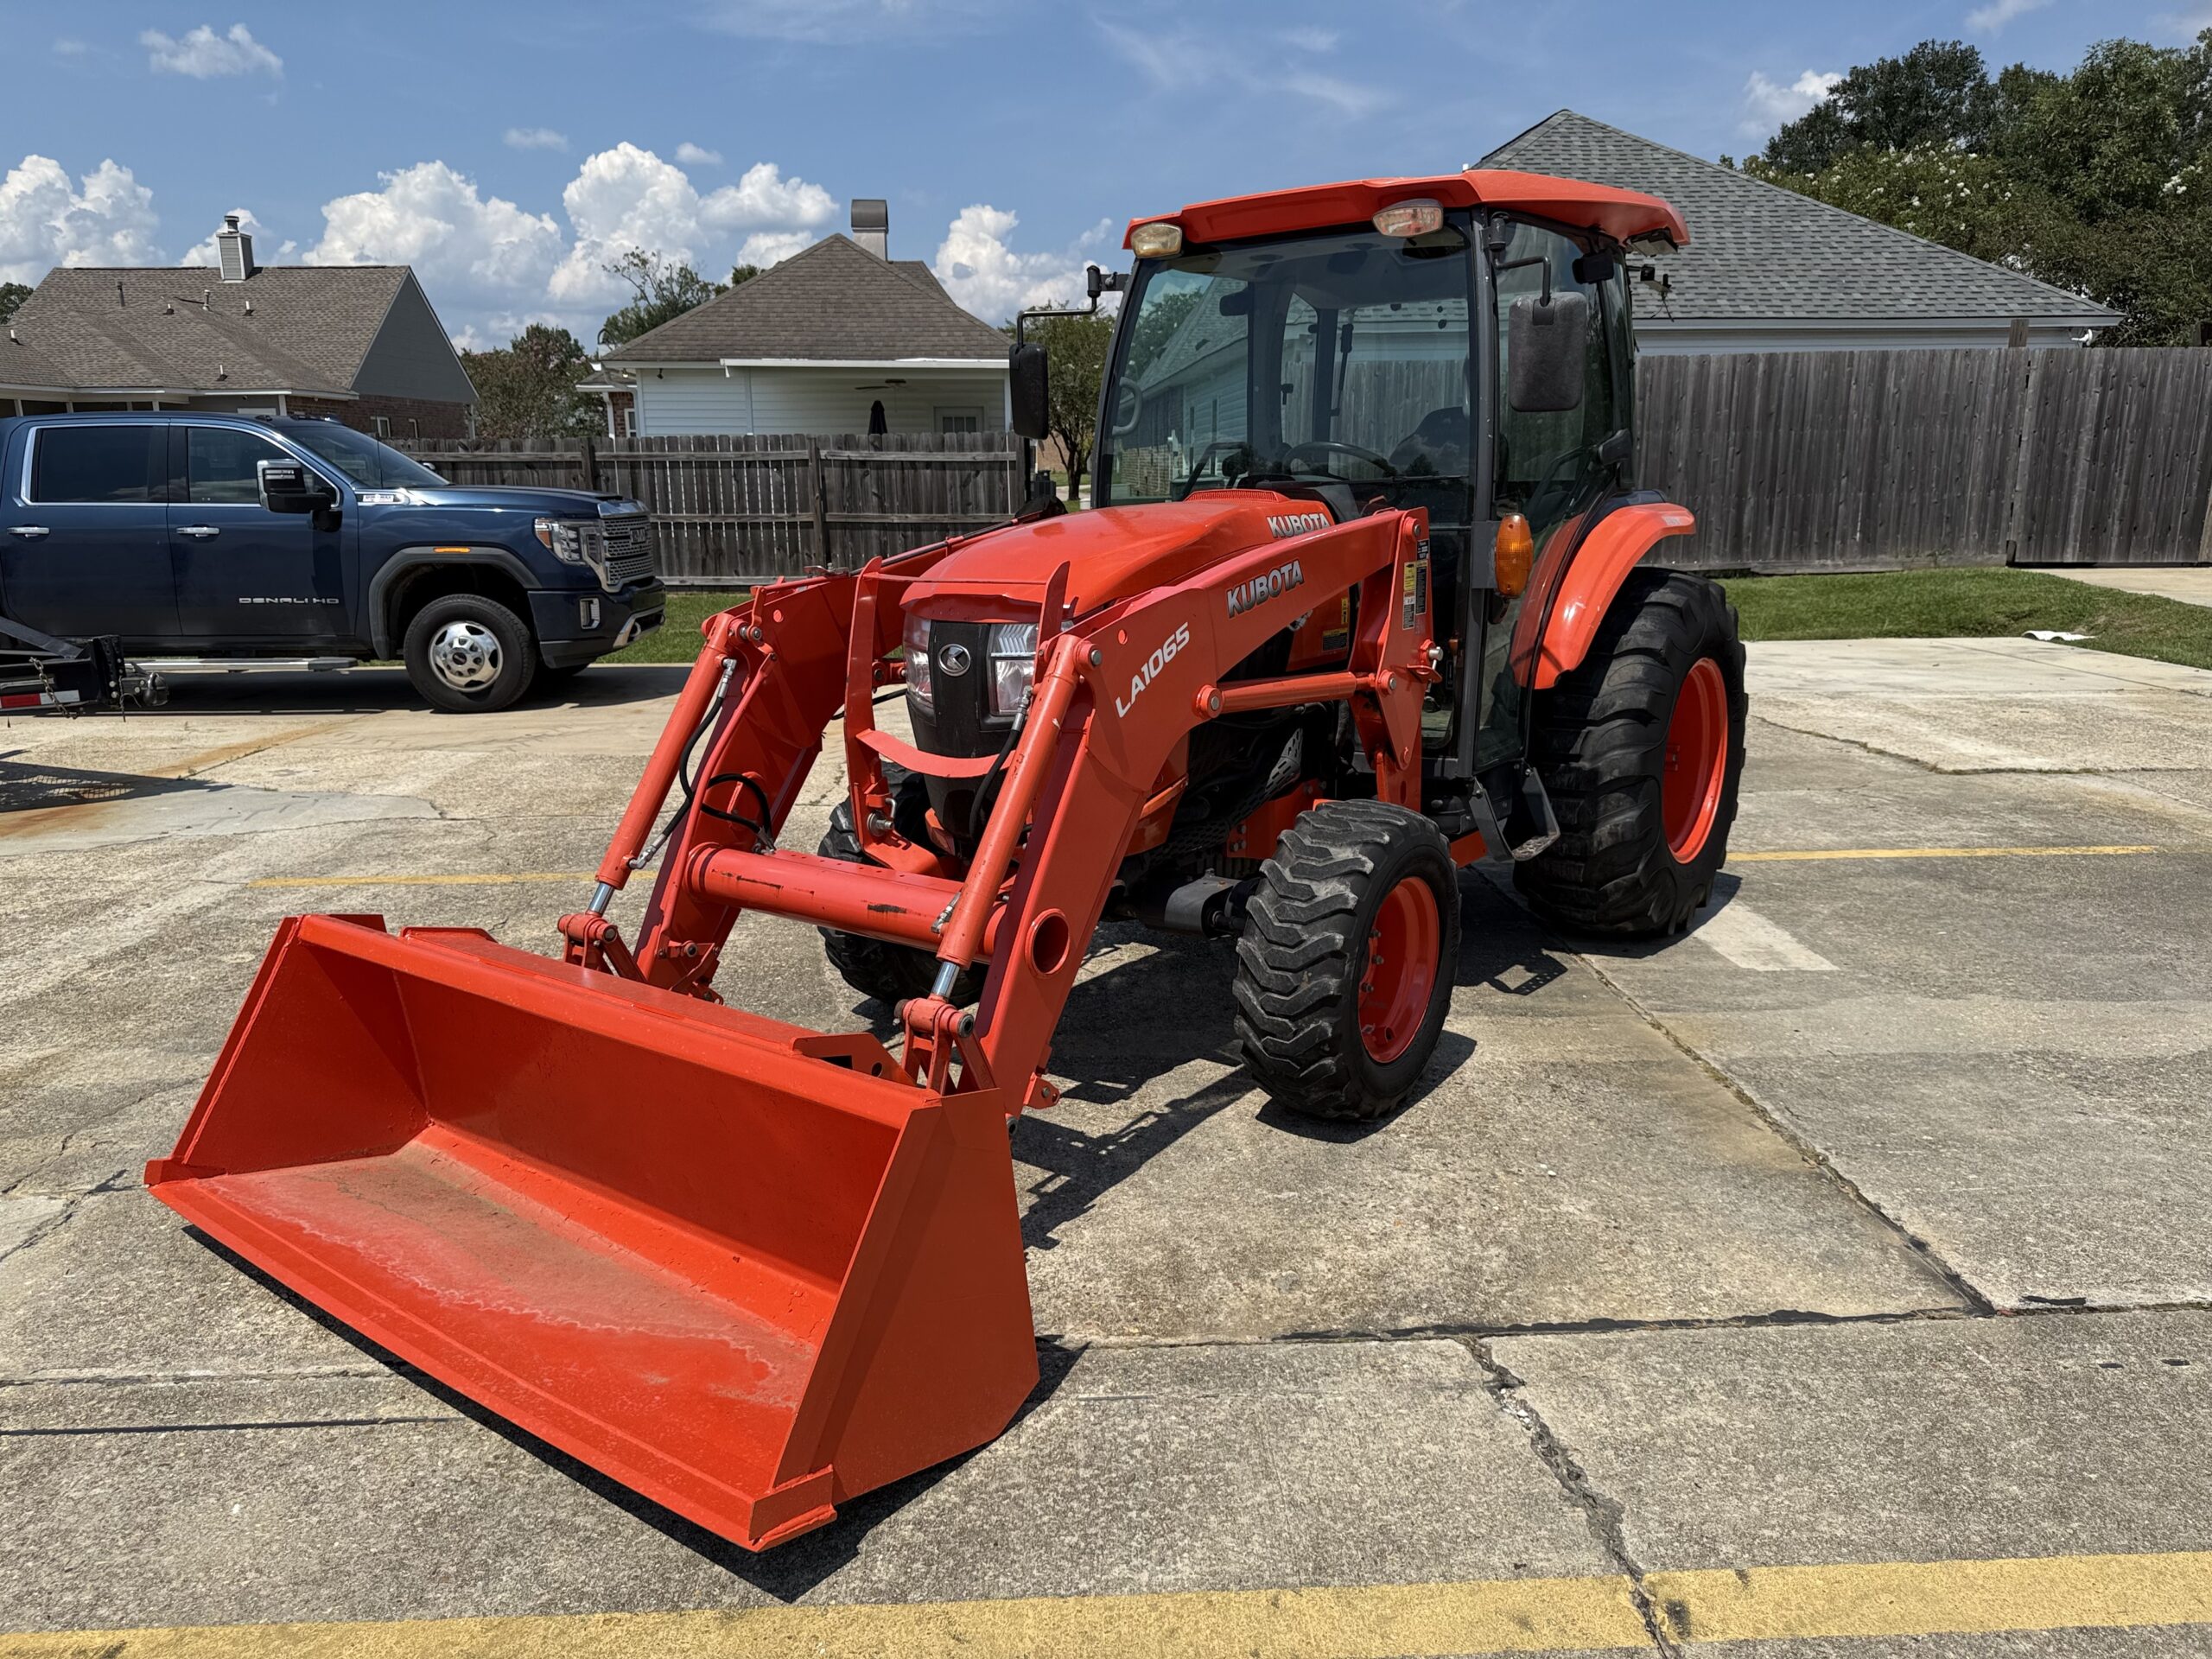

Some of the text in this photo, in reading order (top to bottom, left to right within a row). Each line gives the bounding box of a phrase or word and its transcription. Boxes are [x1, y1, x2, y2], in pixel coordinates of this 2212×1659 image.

[1266, 512, 1331, 538] KUBOTA
[1227, 559, 1305, 619] KUBOTA
[1115, 621, 1190, 718] LA1065
